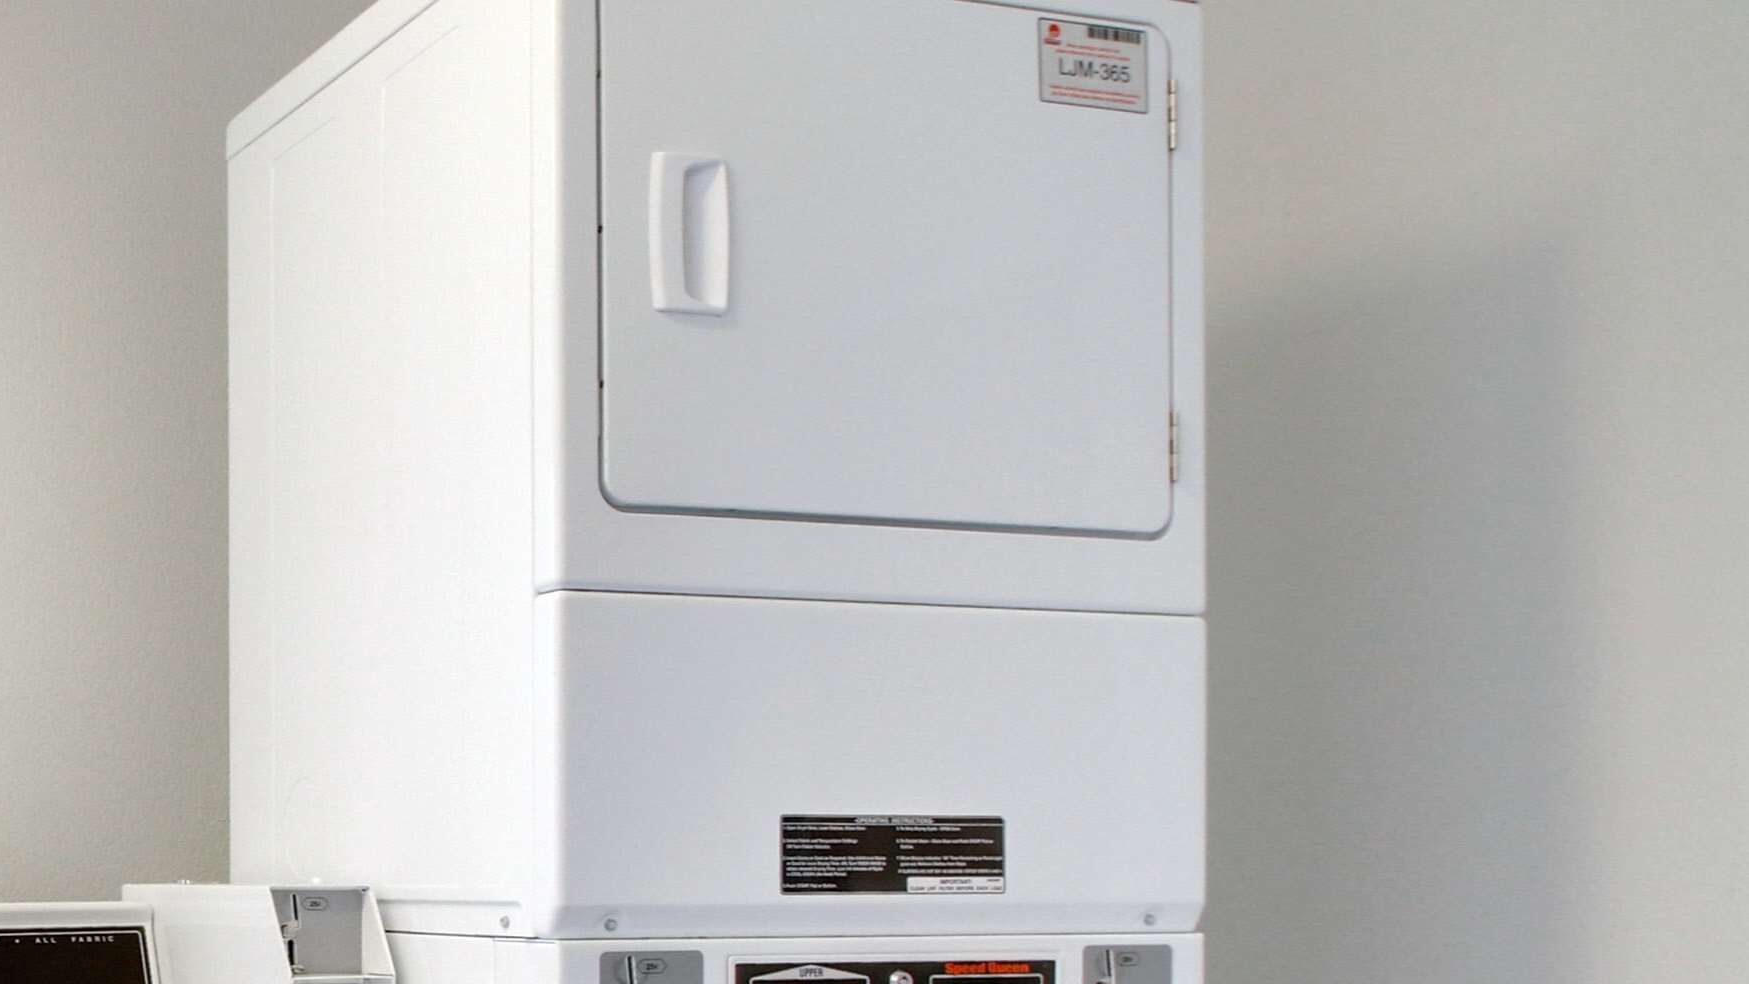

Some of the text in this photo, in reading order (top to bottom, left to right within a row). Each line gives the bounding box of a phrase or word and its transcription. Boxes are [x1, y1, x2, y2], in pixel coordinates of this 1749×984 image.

[1059, 58, 1131, 83] LJM-365
[799, 968, 824, 977] UPPER
[945, 963, 1030, 975] Speed Queen
